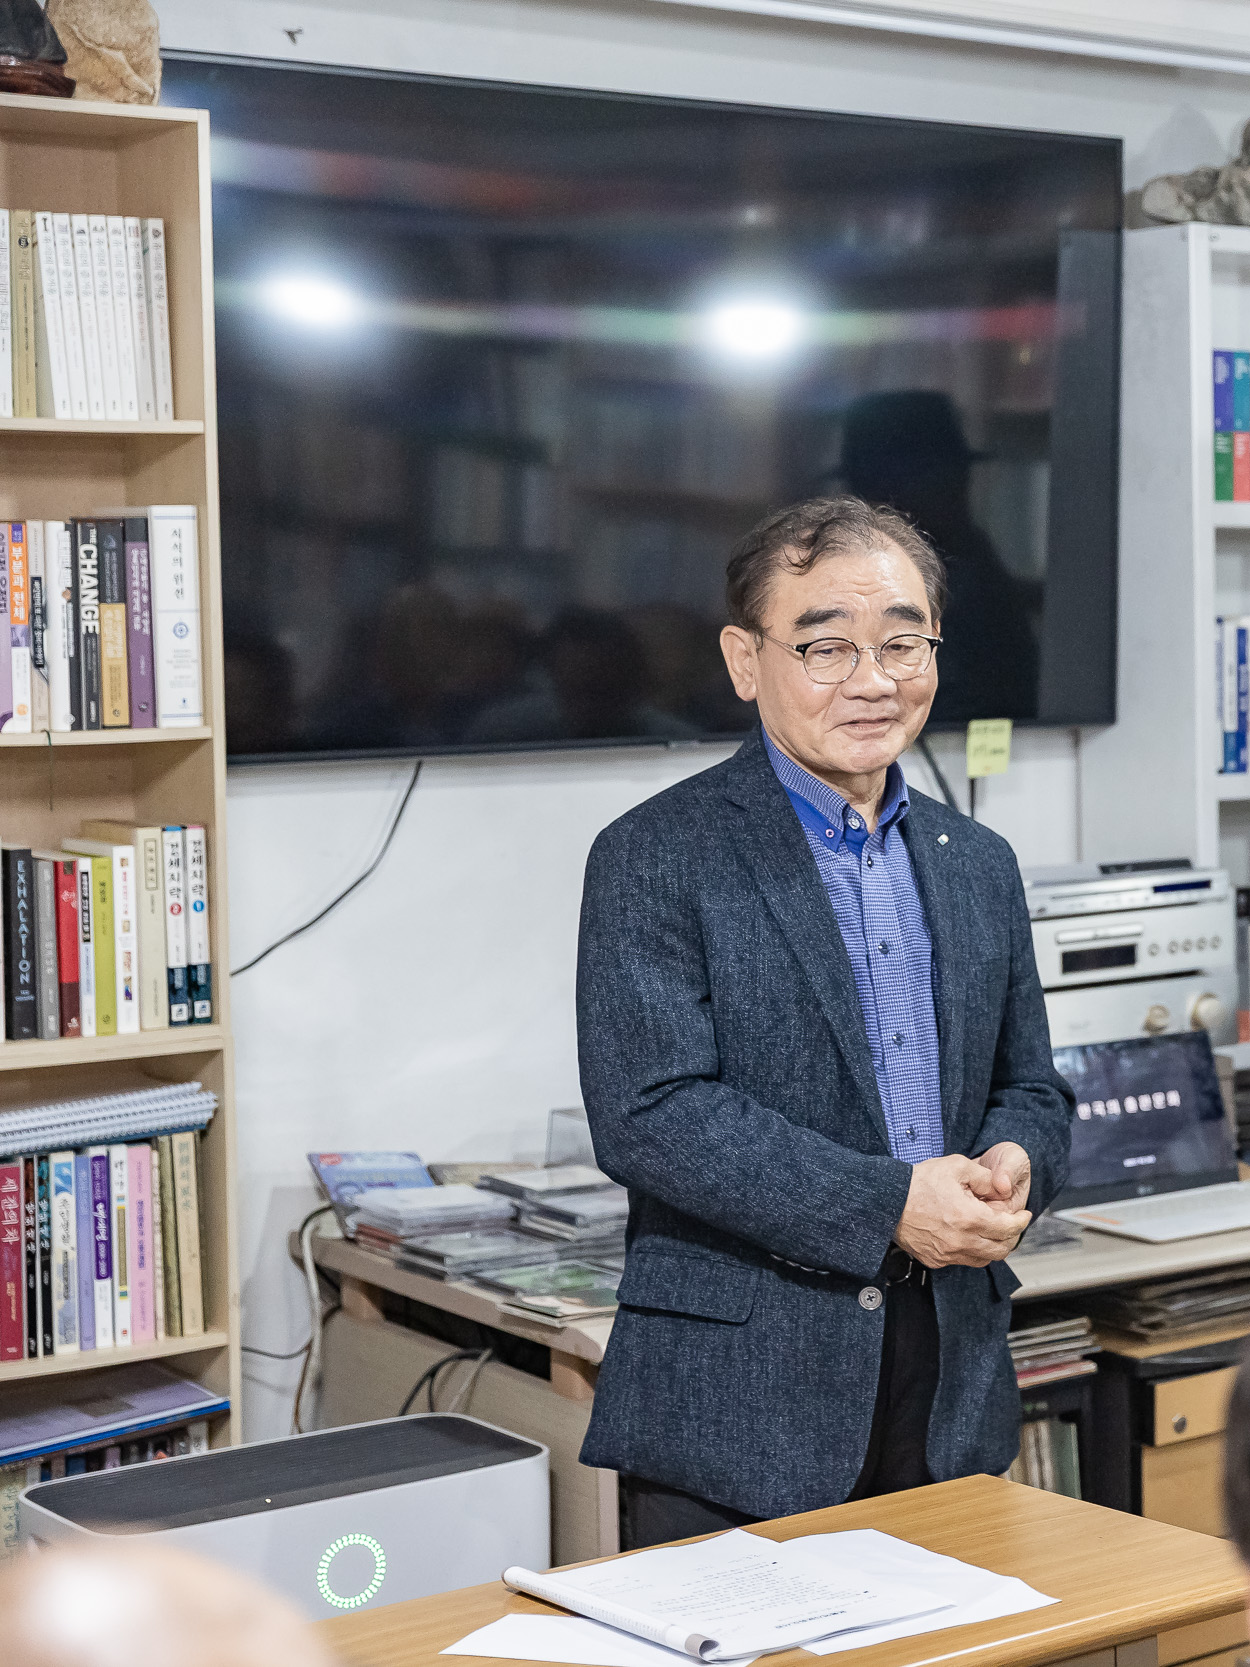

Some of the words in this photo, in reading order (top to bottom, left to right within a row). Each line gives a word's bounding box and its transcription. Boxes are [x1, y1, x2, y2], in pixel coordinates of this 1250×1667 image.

[88, 528, 98, 544] THE
[80, 543, 100, 634] CHANGE
[16, 860, 31, 984] EXHALATION
